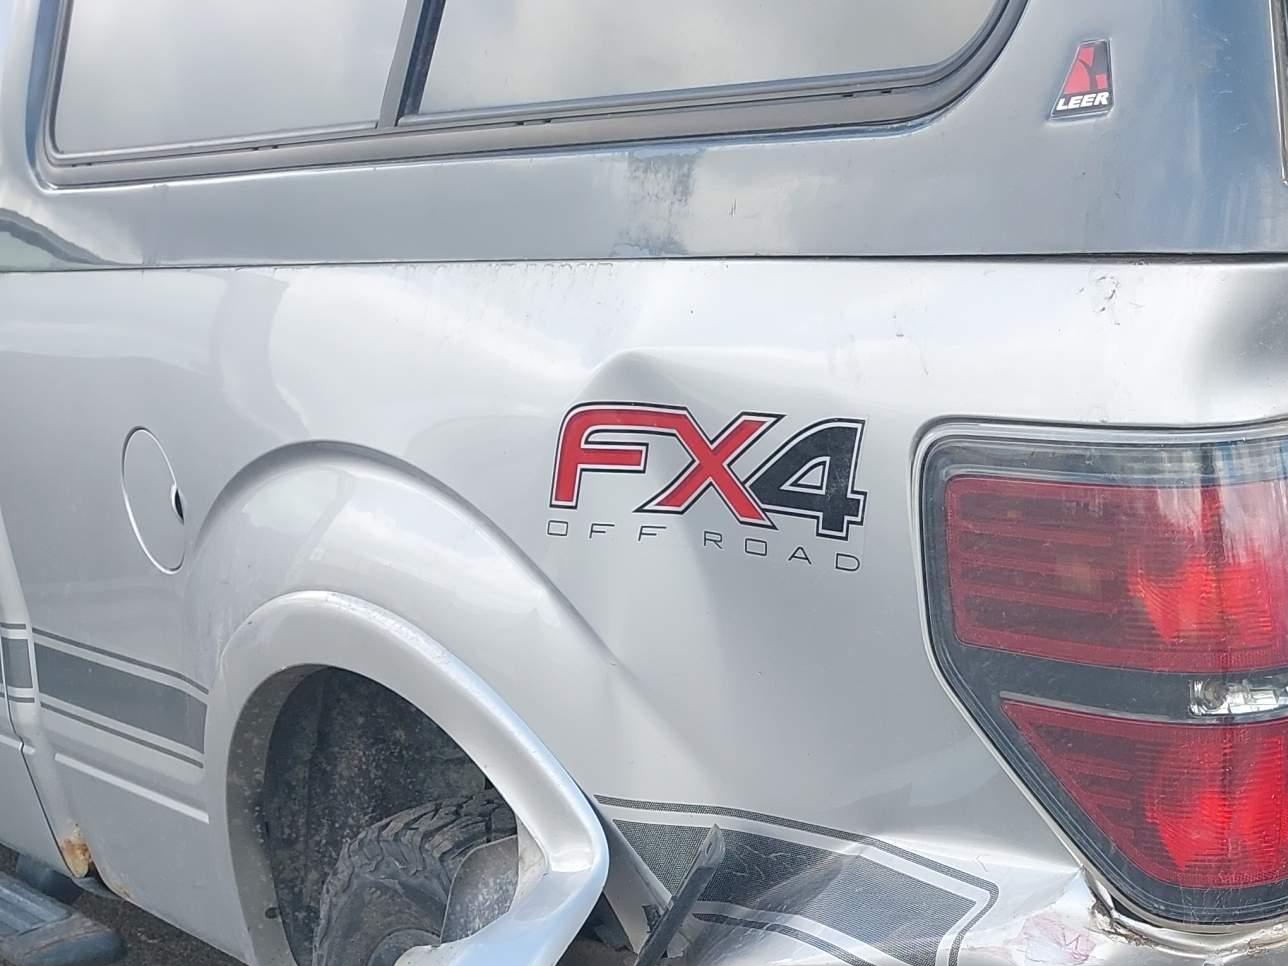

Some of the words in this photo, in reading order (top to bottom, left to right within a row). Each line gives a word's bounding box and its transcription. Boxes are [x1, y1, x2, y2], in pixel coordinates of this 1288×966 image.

[1056, 91, 1110, 111] LEER
[549, 401, 868, 541] FX4
[547, 520, 667, 542] OFF
[703, 530, 861, 572] ROAD
